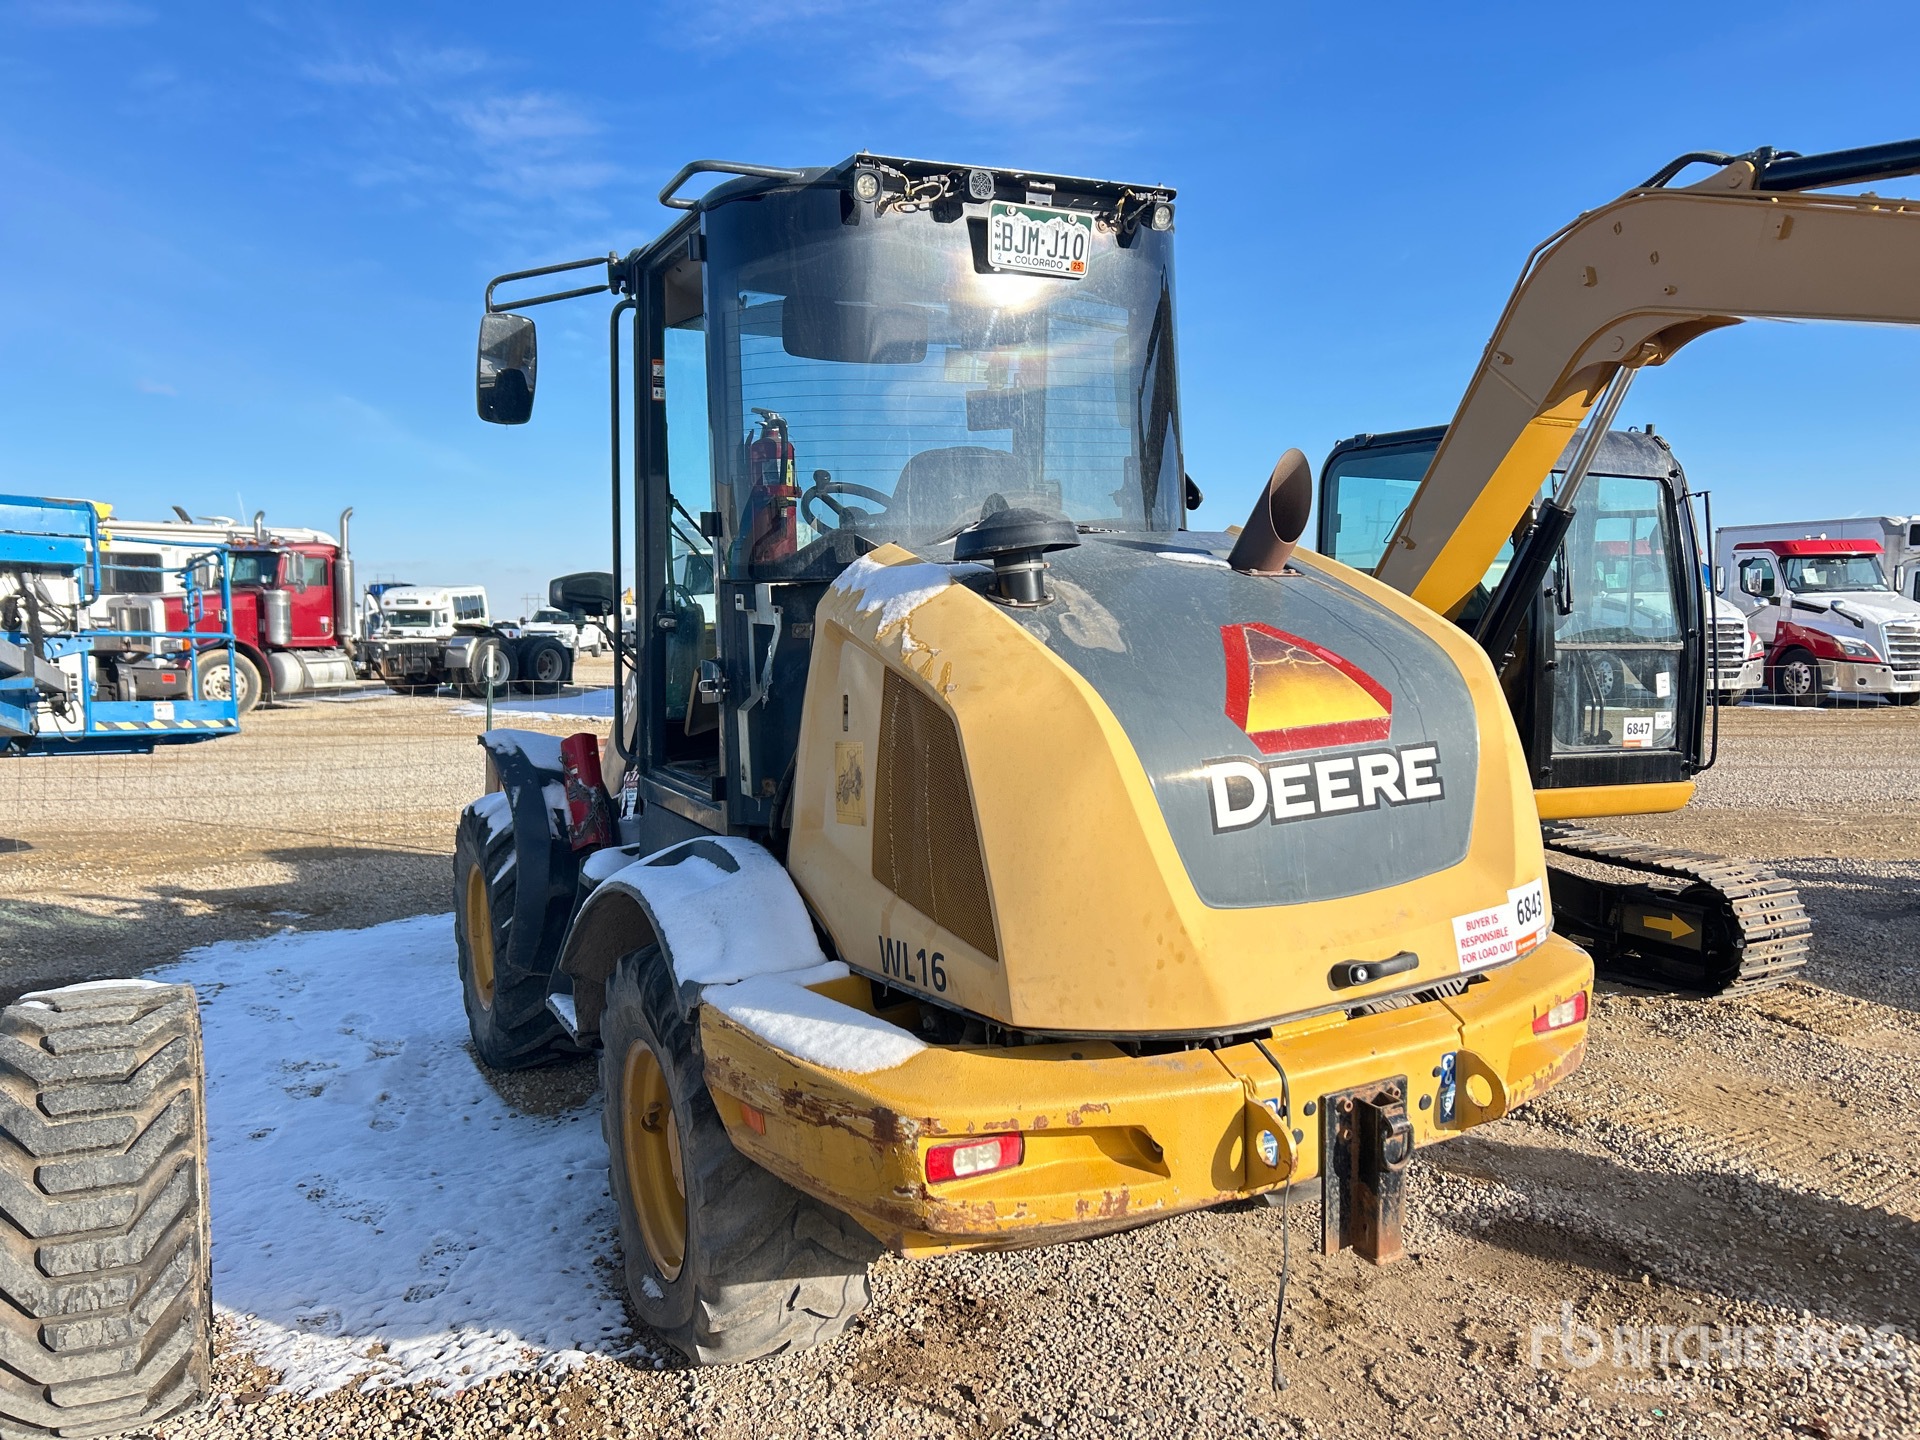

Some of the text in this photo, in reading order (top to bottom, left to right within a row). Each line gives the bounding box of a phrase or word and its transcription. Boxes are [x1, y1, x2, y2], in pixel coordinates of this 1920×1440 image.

[1014, 255, 1064, 269] COLORADO
[1626, 722, 1650, 735] 6847
[1206, 746, 1442, 830] DEERE
[1516, 890, 1542, 926] 6843
[1465, 913, 1499, 932] BUYER IS
[1460, 926, 1509, 949] RESPONSIBLE
[878, 935, 947, 993] WL16
[1461, 952, 1477, 965] FOR
[1478, 945, 1499, 960] LOAD
[1499, 941, 1514, 954] OUT
